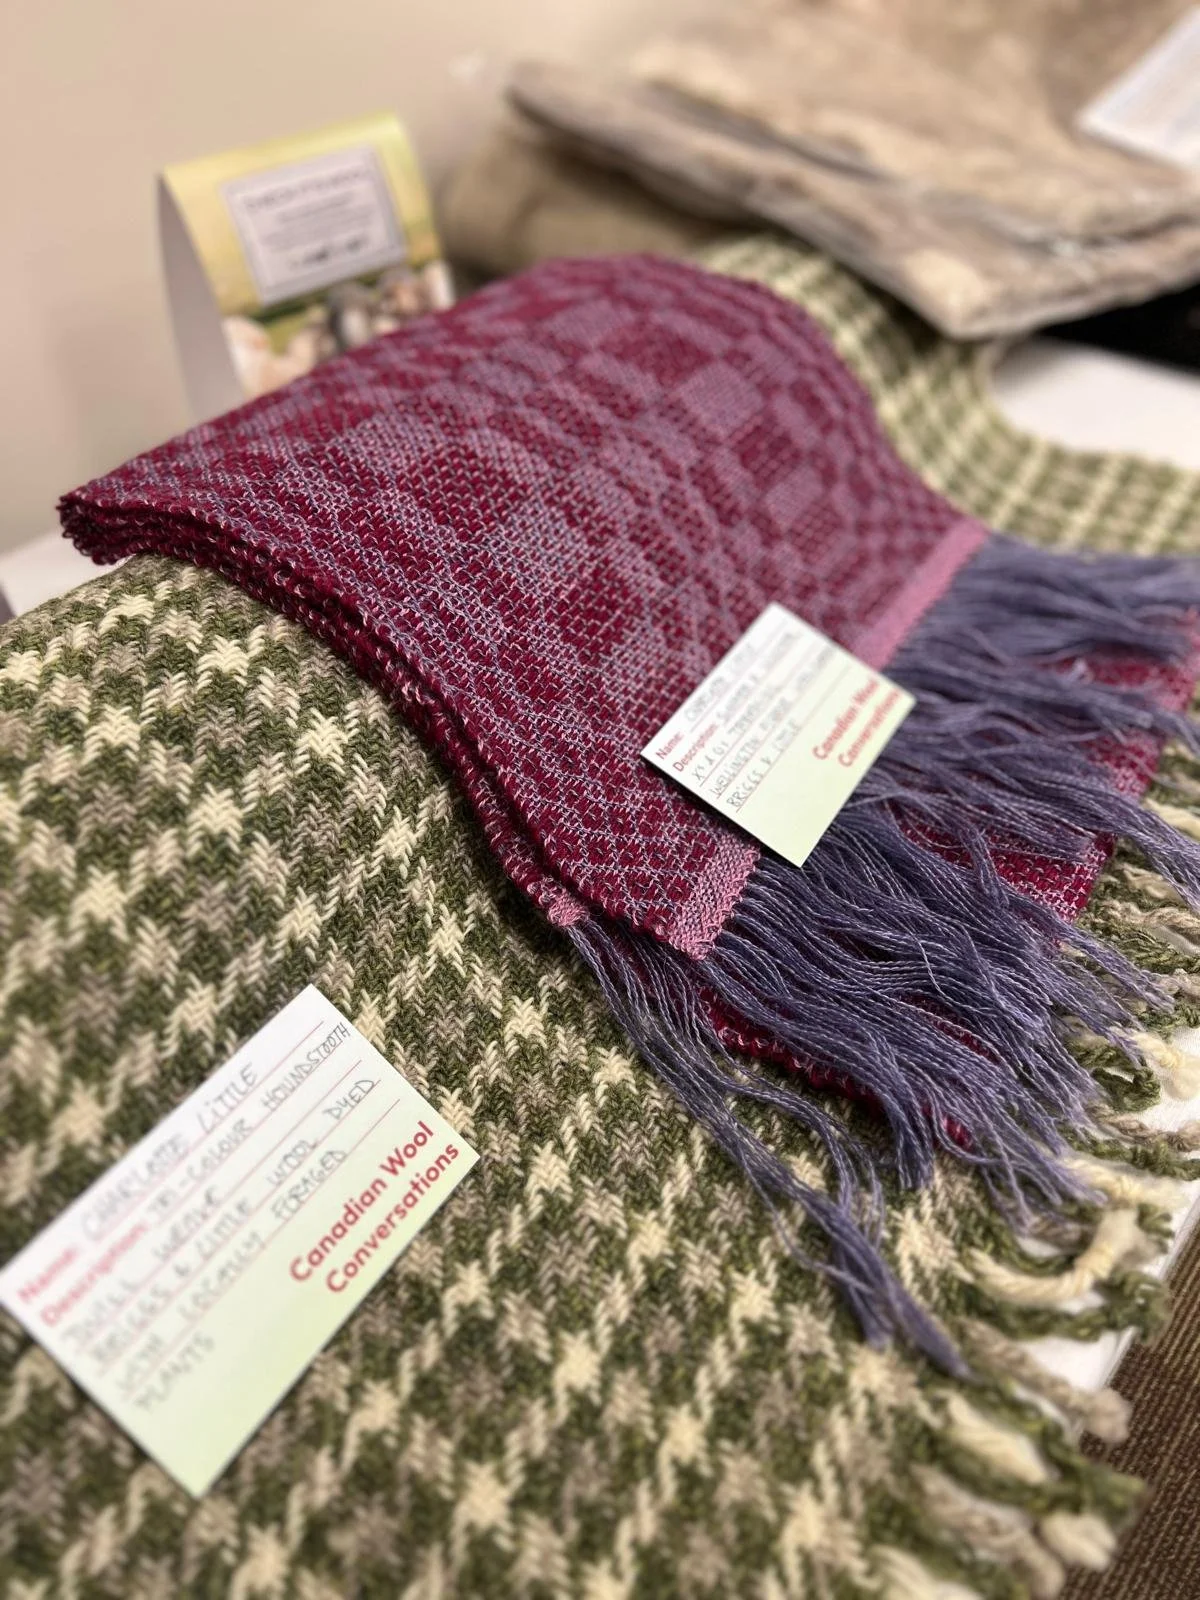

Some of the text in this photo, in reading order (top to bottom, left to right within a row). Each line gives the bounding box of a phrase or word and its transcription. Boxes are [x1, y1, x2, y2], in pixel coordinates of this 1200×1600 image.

[258, 1021, 351, 1113] HOUNDSTOOTH
[263, 1130, 320, 1189] WOOL
[320, 1069, 376, 1127] DYED
[267, 1139, 348, 1225] FORAGED
[282, 1117, 435, 1289] Canadian Wool
[320, 1136, 461, 1298] Conversations
